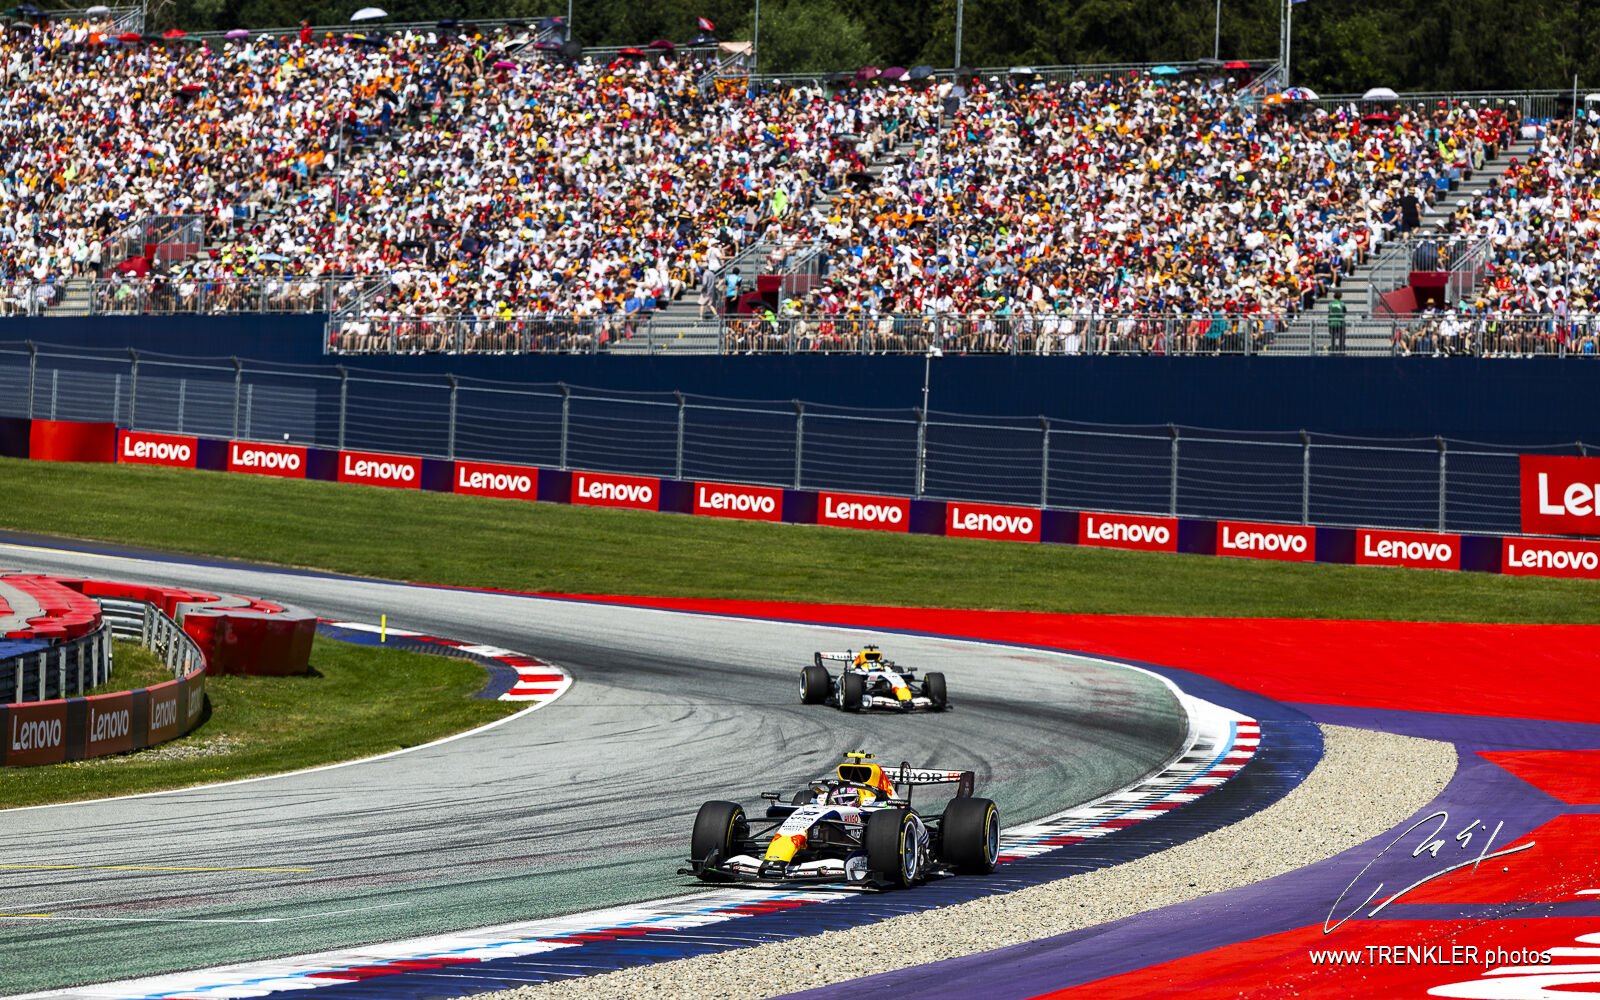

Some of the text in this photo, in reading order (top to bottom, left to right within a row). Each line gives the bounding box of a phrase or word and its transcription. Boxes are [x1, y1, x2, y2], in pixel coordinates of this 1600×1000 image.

[124, 436, 191, 461] Lenovo
[233, 445, 301, 470] Lenovo
[344, 456, 415, 481] Lenovo
[459, 466, 531, 493] Lenovo
[578, 476, 653, 503] Lenovo
[699, 487, 775, 513] Lenovo
[825, 497, 903, 524] Lenovo
[952, 508, 1034, 534] Lenovo
[1087, 516, 1170, 545] Lenovo
[1222, 526, 1308, 553] Lenovo
[1364, 534, 1452, 562] Lenovo
[1508, 544, 1599, 570] Lenovo
[90, 708, 130, 743] Lenovo
[151, 697, 177, 731] Lenovo
[12, 715, 62, 751] Lenovo
